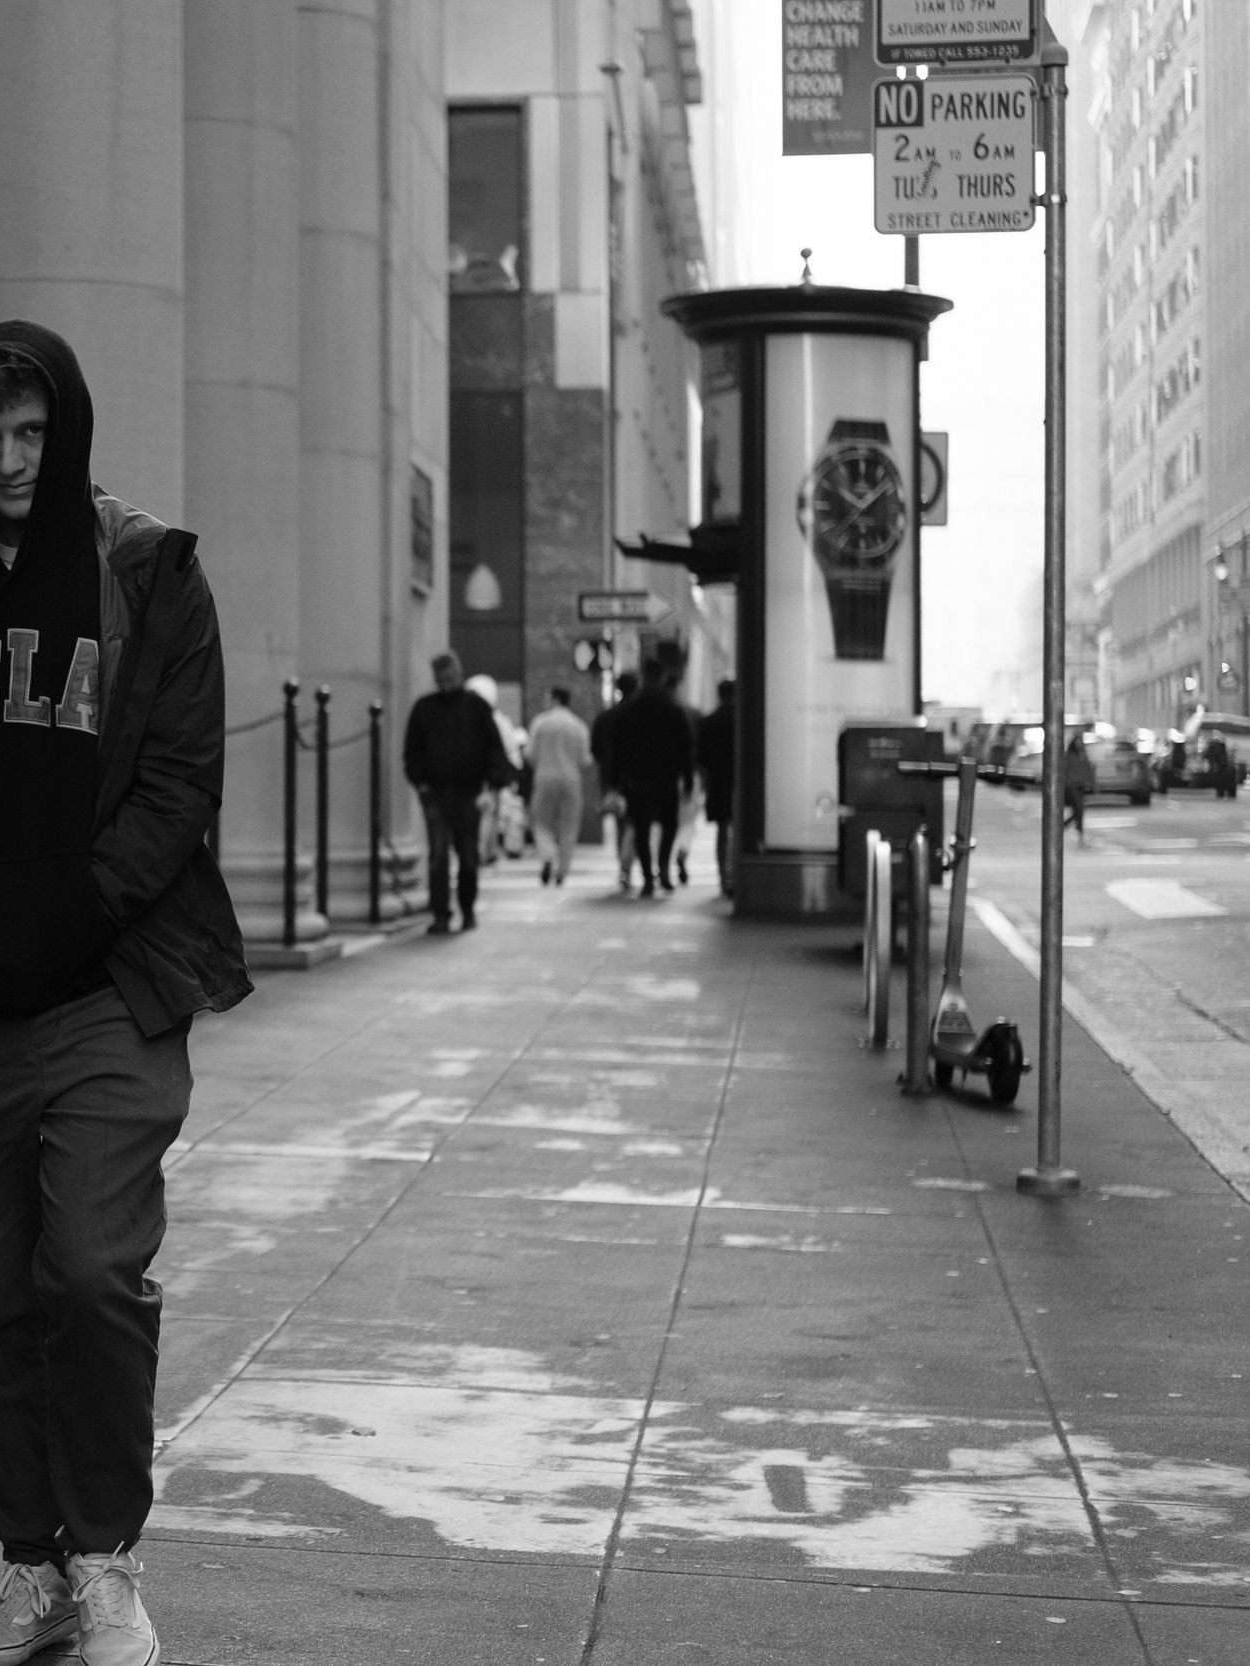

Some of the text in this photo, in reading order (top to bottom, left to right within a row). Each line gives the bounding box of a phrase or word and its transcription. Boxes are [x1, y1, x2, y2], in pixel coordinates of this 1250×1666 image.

[786, 0, 864, 23] CHANGE
[951, 0, 965, 13] TO
[786, 24, 859, 47] HEALTH
[888, 18, 1023, 37] SATURDAY AND SUNDAY
[786, 49, 837, 72] CARE
[938, 46, 965, 59] CALL
[786, 73, 843, 96] FROM
[879, 83, 1025, 124] NO PARKING
[956, 173, 1016, 198] THURS
[887, 210, 1022, 229] STREET CLEANING
